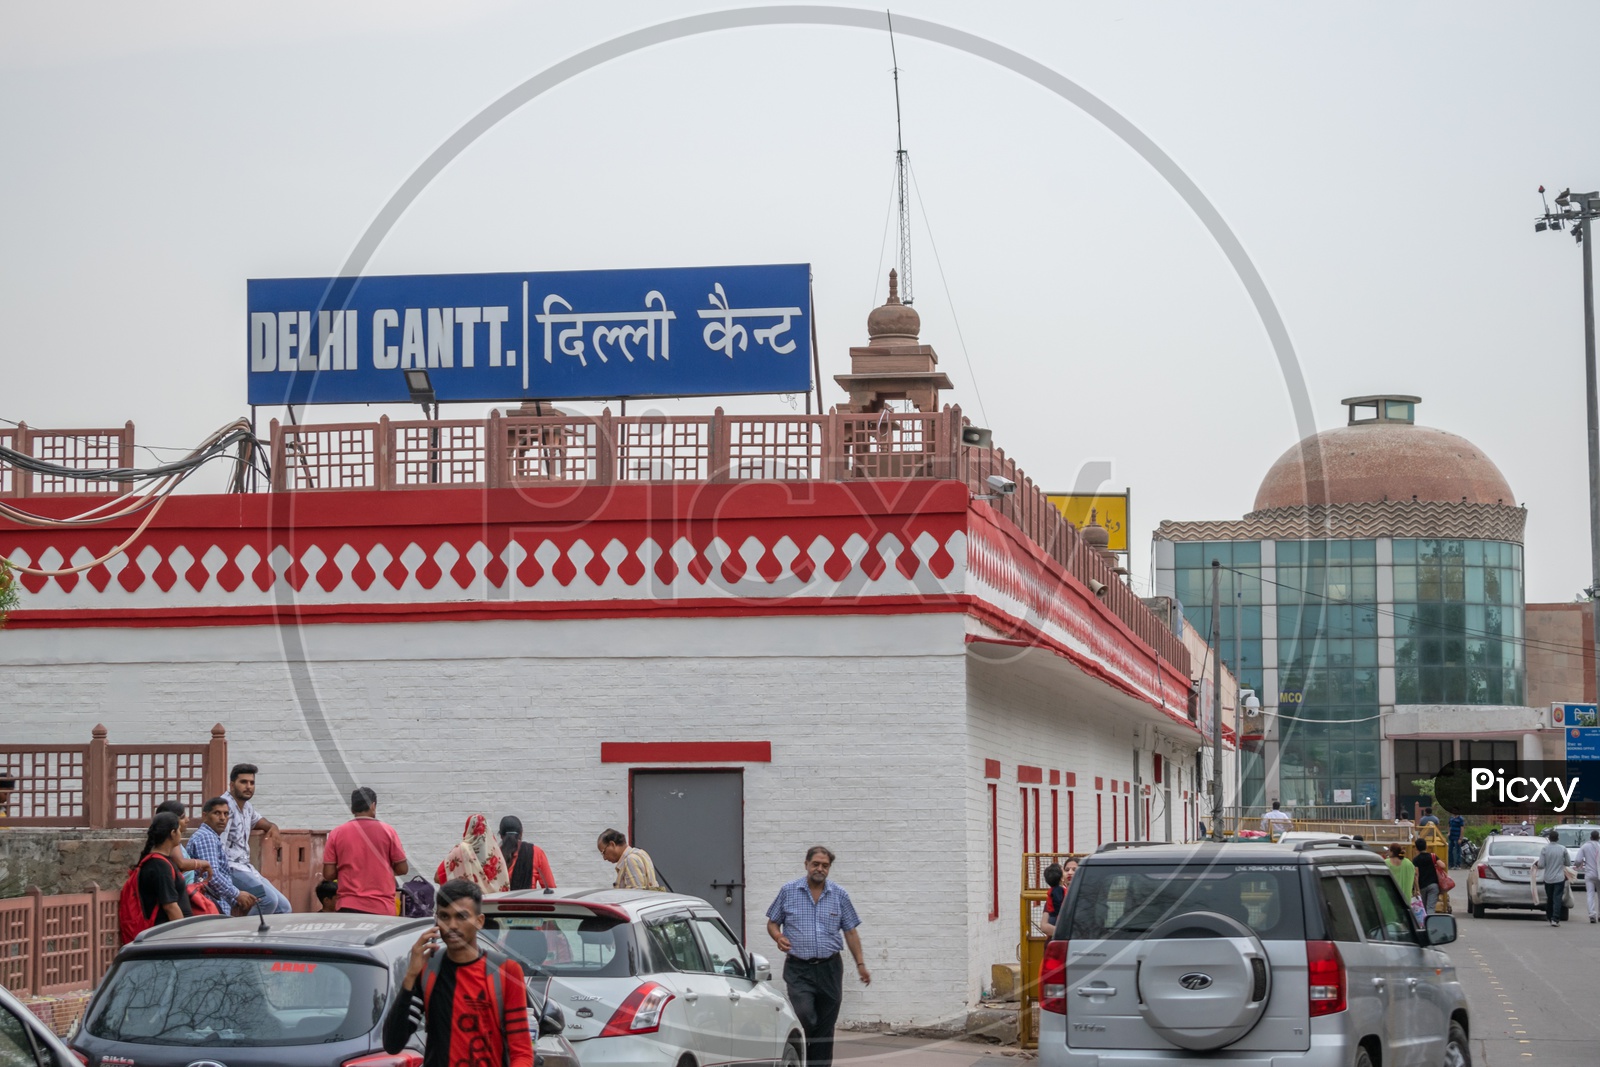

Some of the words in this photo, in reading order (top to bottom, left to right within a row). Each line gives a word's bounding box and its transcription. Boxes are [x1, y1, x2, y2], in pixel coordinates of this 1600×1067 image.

[534, 289, 677, 367] दिल्ली
[696, 281, 803, 359] कैन्ट
[250, 309, 358, 373] DELHI
[372, 305, 516, 370] CANTT.
[1279, 692, 1303, 703] MCO
[271, 961, 318, 974] ARMY
[570, 995, 603, 1003] SWIFT
[102, 1055, 135, 1065] Sikka
